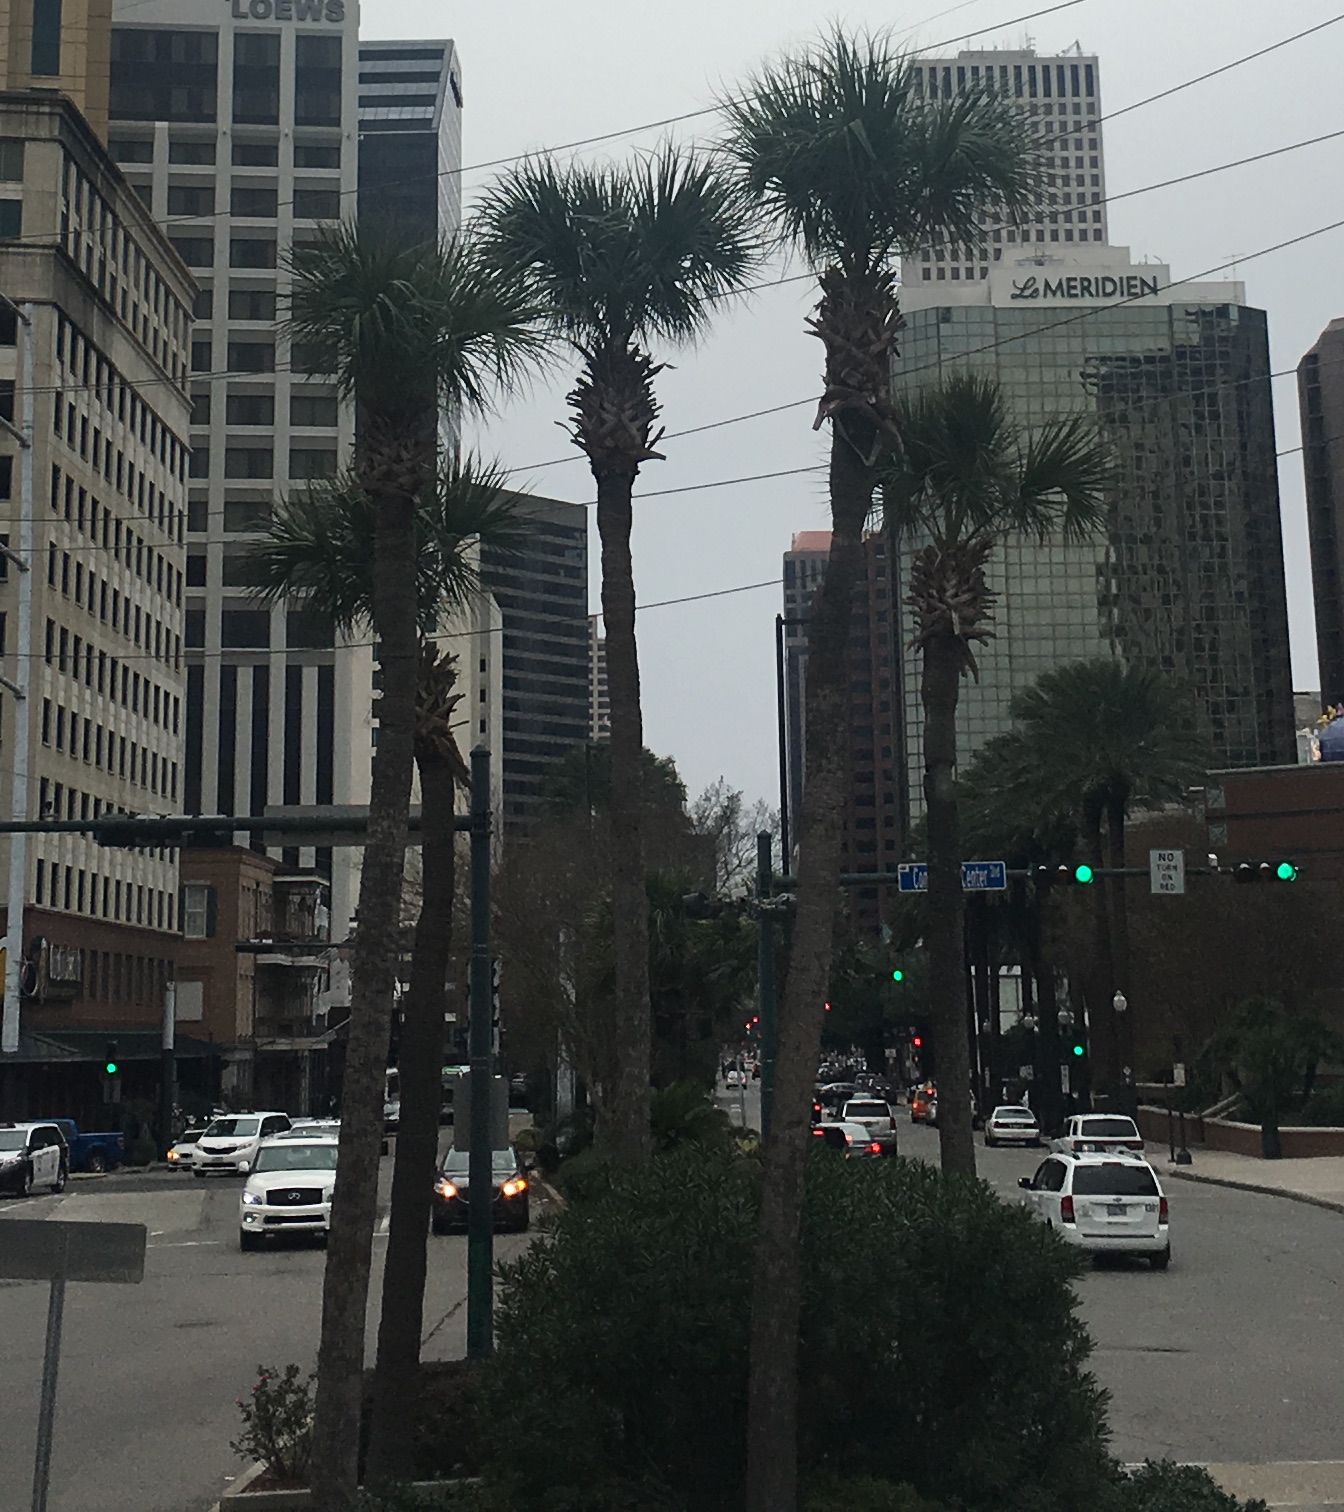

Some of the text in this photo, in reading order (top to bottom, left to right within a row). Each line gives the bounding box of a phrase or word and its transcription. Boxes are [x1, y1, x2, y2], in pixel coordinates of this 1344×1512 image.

[1010, 275, 1158, 300] Le MERIDIEN
[1158, 853, 1174, 862] NO
